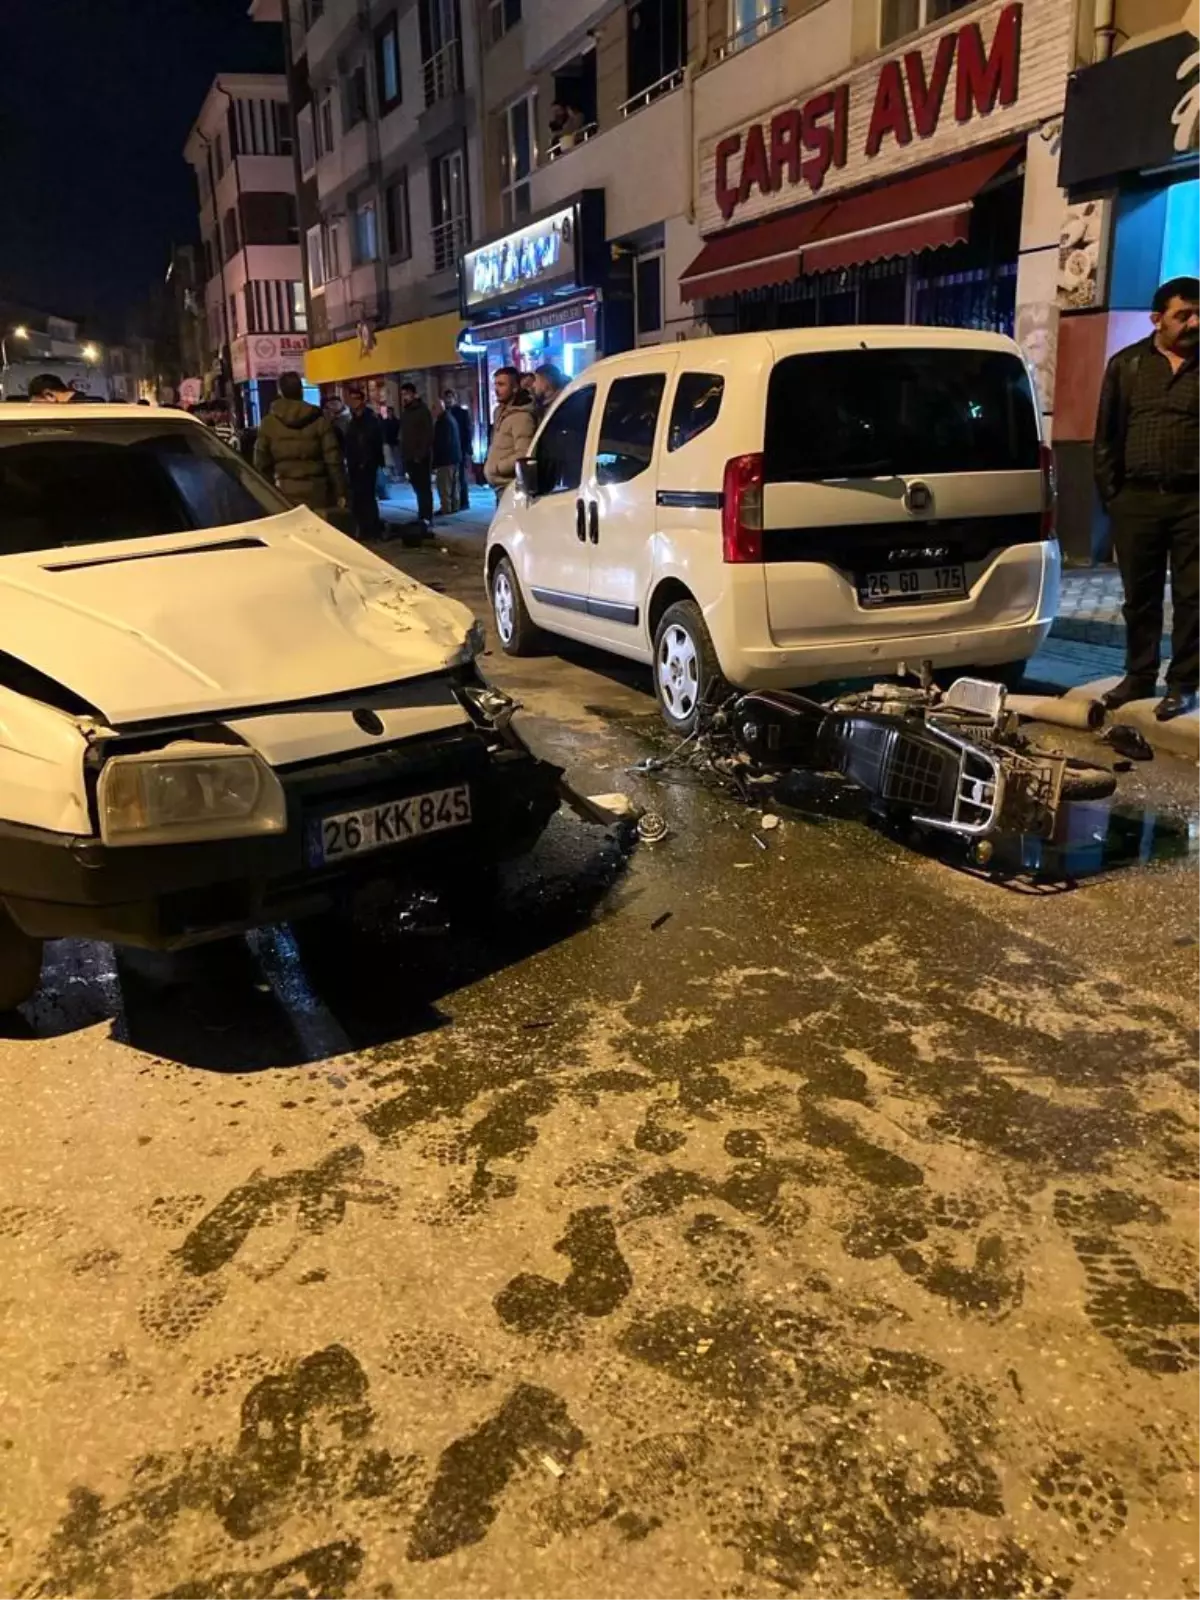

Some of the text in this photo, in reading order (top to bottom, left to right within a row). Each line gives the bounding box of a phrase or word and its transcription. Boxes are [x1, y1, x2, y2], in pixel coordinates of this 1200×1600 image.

[714, 85, 850, 221] ÇARŞI
[865, 2, 1024, 157] AVM
[868, 574, 890, 596] 26
[935, 567, 962, 590] 175
[323, 788, 470, 856] 26 KK 845
